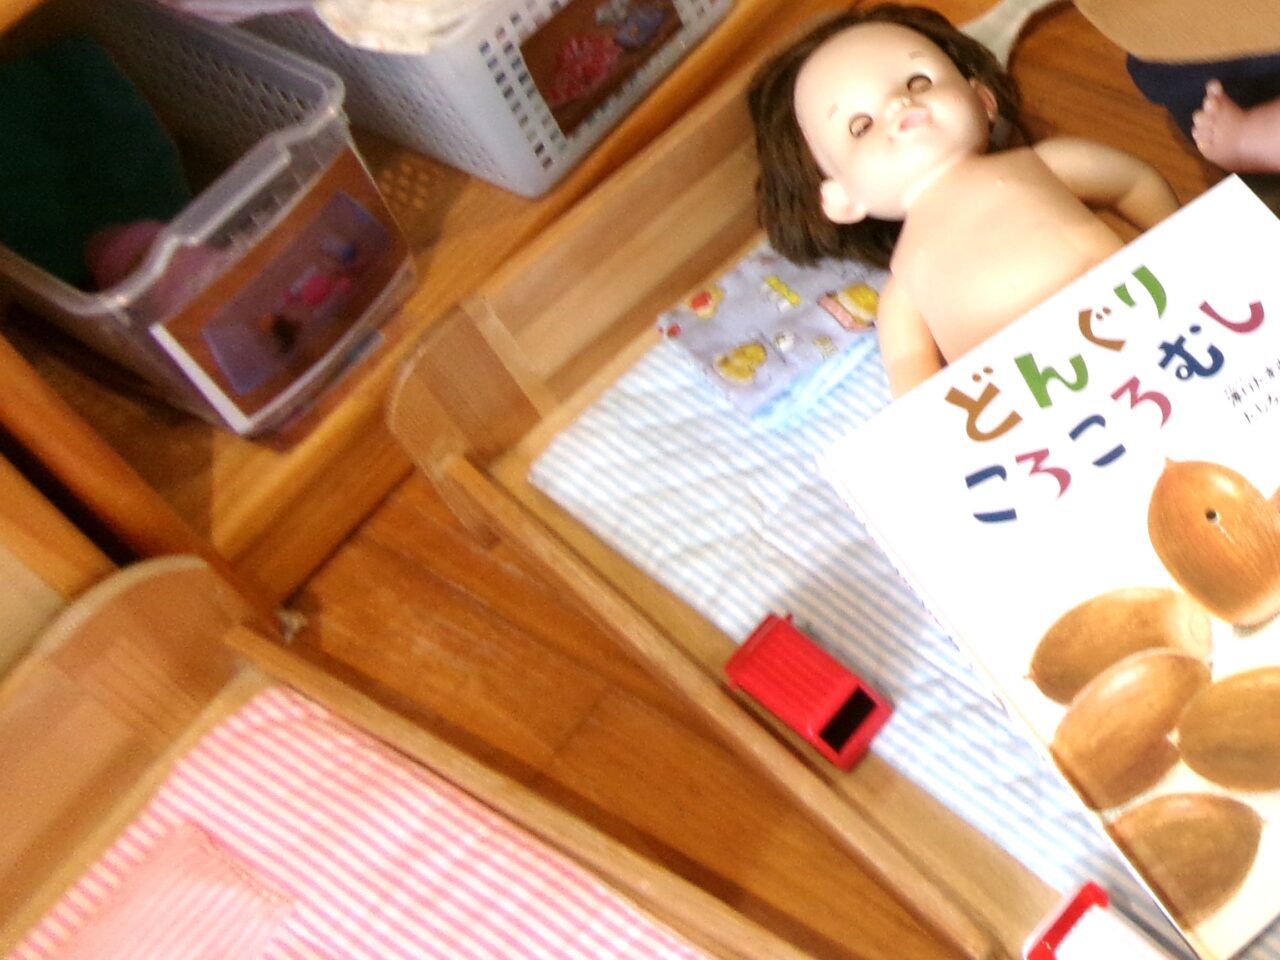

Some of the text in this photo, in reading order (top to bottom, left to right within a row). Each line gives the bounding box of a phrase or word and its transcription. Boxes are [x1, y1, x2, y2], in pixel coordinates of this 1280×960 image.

[944, 265, 1168, 442] どんぐり
[964, 301, 1265, 523] ころころむし
